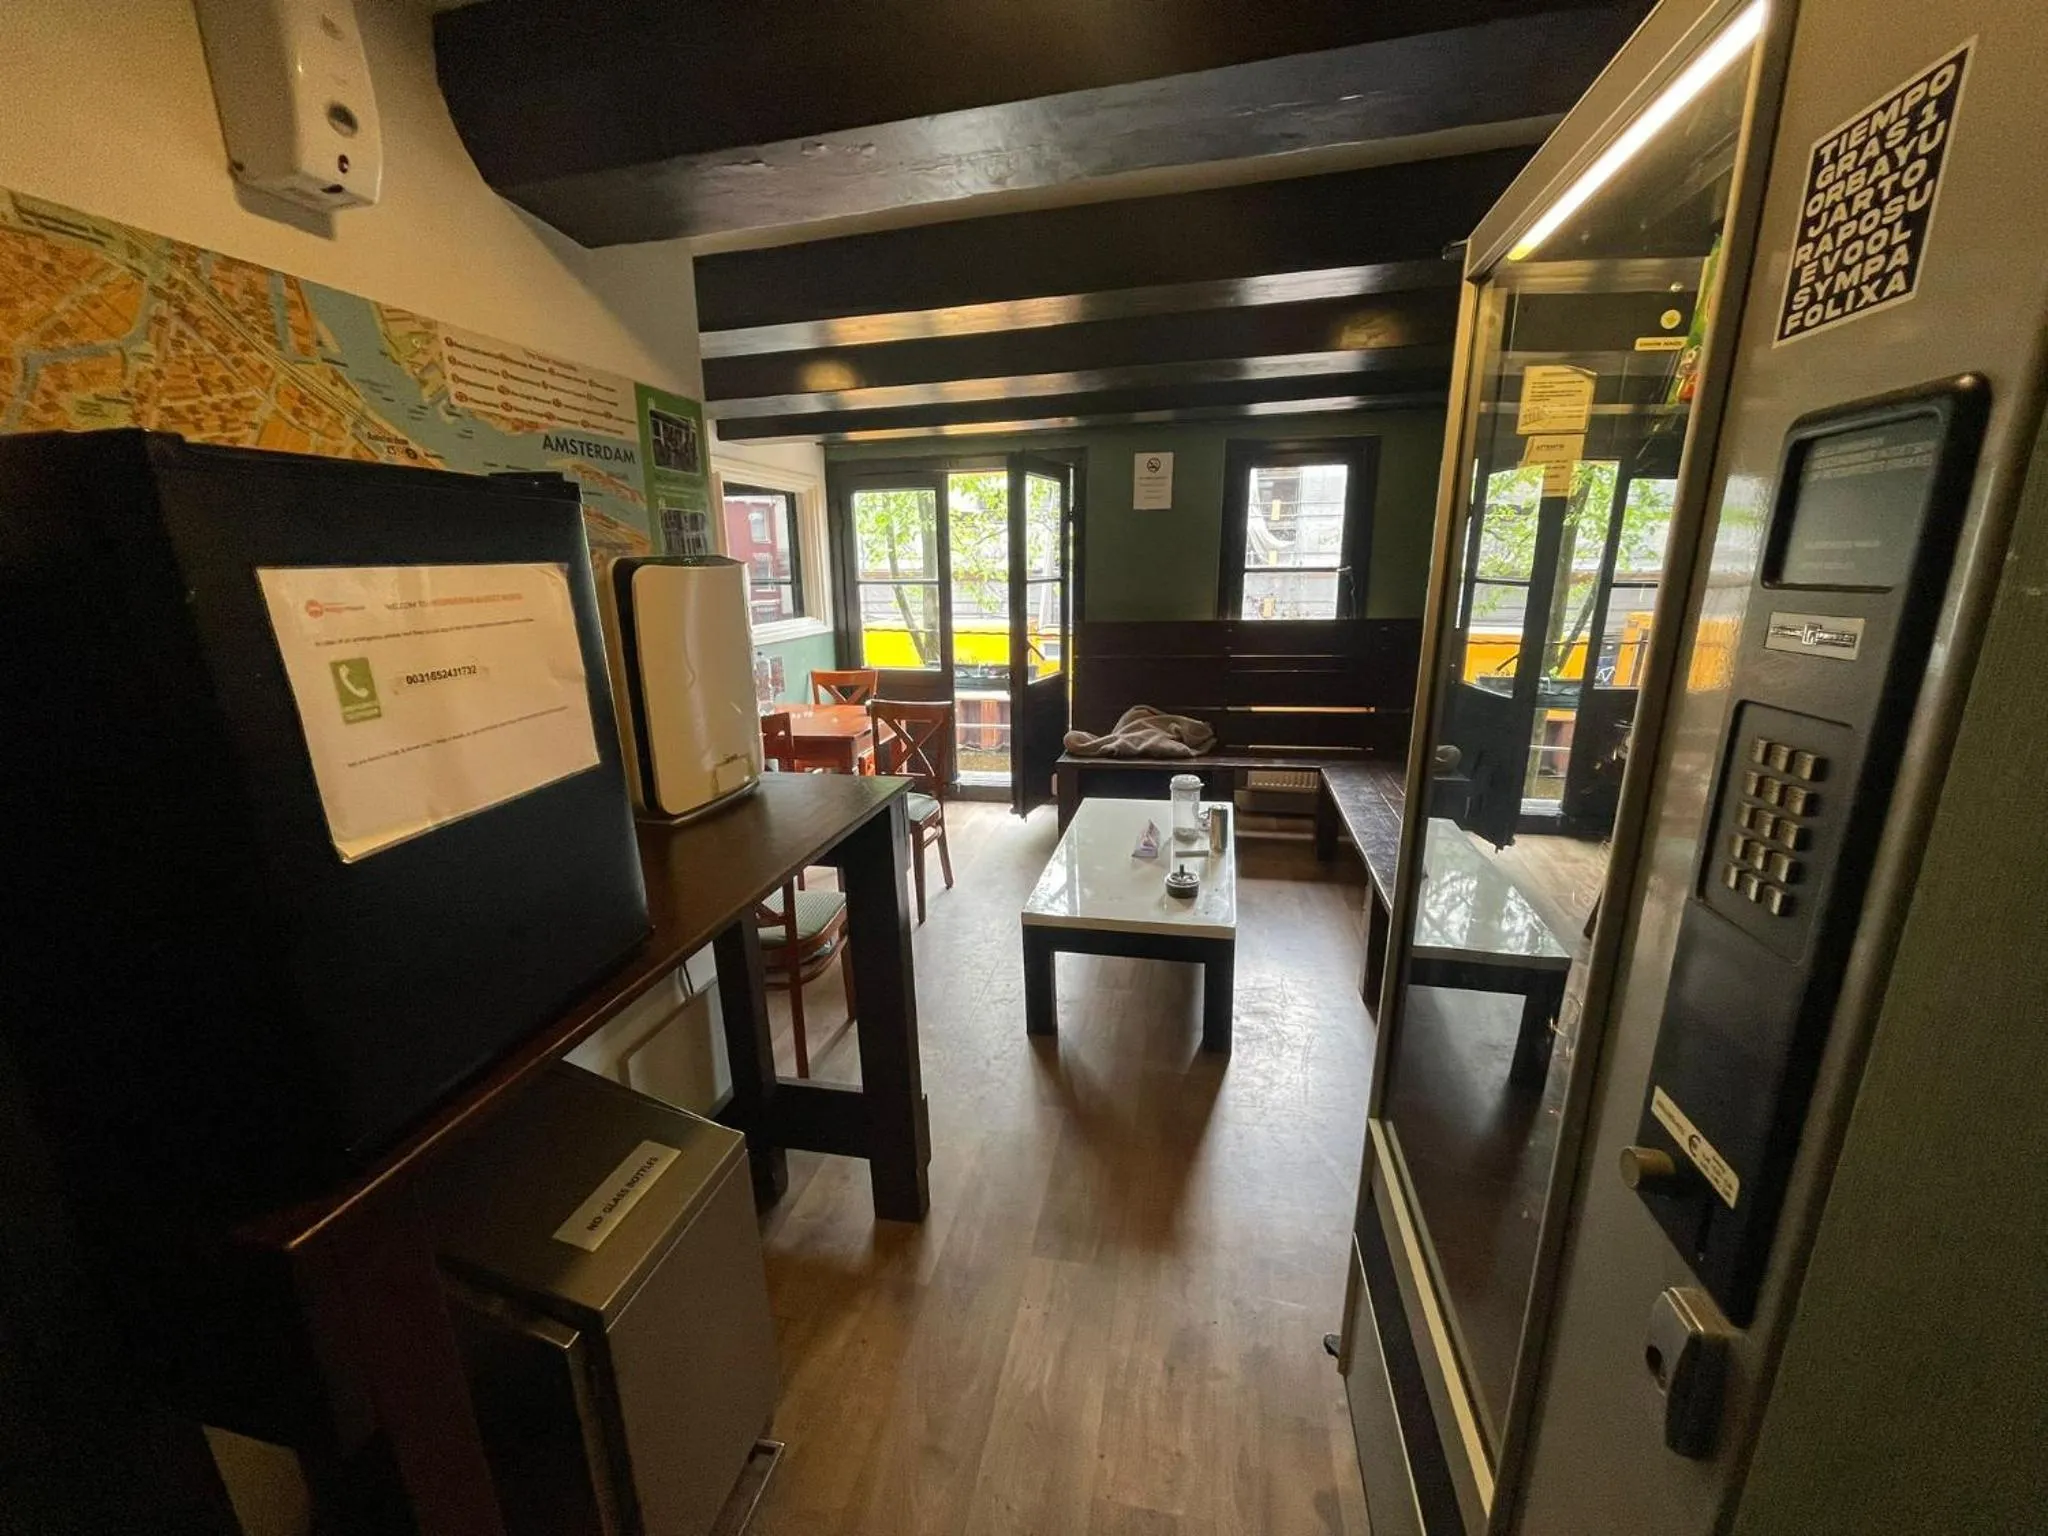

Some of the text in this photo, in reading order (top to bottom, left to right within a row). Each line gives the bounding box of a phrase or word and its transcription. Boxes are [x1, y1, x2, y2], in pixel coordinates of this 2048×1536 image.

[1820, 64, 1955, 165] TIEMPO
[1806, 120, 1945, 217] ORBAYU
[1808, 159, 1926, 237] JARTO
[1795, 180, 1933, 268] RAPOSU
[1800, 220, 1911, 286] EVOOL
[1785, 271, 1905, 335] FOLIXA
[1792, 244, 1908, 310] SYMPA
[542, 434, 636, 464] AMSTERDAM
[586, 1216, 602, 1231] NO
